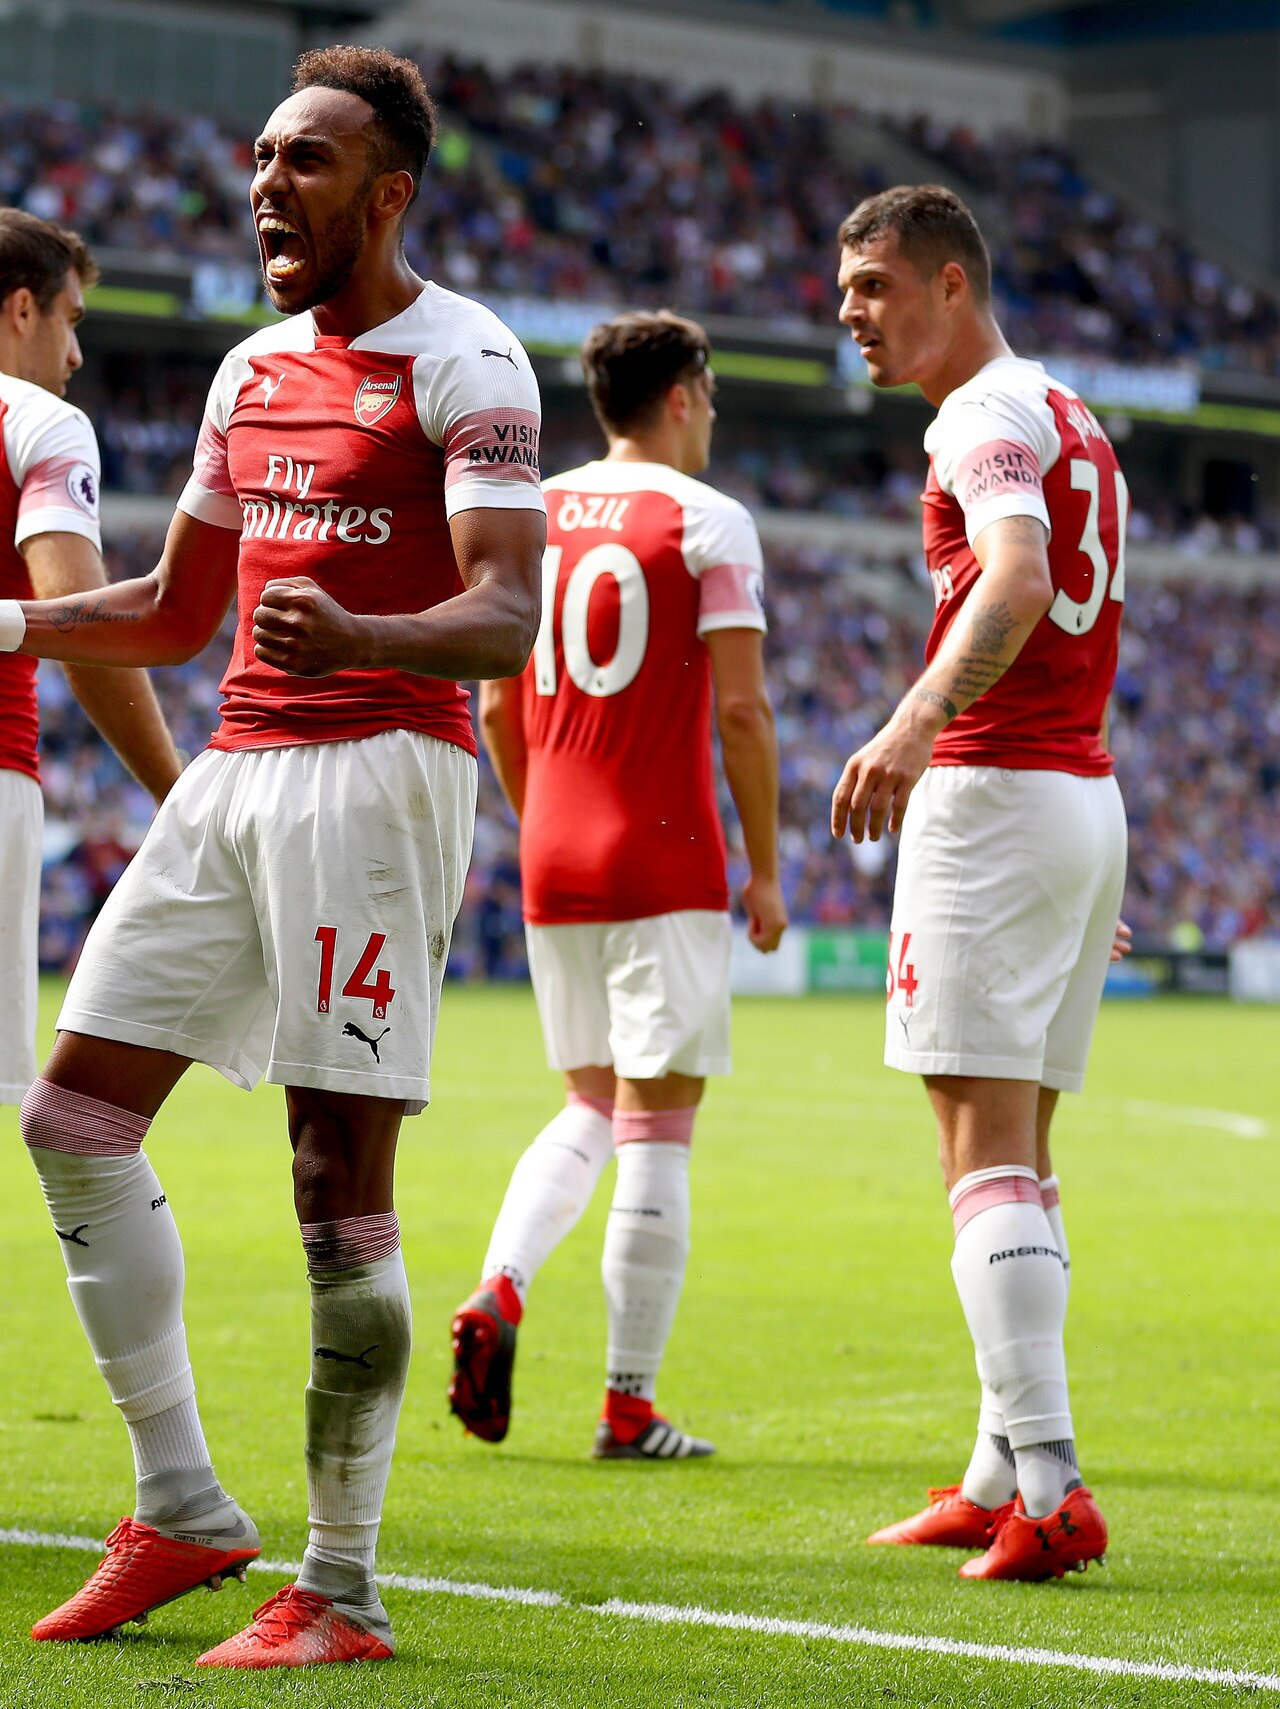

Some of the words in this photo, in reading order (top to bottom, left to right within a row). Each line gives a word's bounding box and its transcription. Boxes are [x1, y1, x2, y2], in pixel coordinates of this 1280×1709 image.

[363, 380, 397, 391] Arsenal
[263, 454, 316, 500] Fly
[972, 452, 1024, 477] VISIT
[557, 493, 630, 532] ÖZIL
[533, 542, 650, 698] 10
[314, 924, 397, 1021] 14
